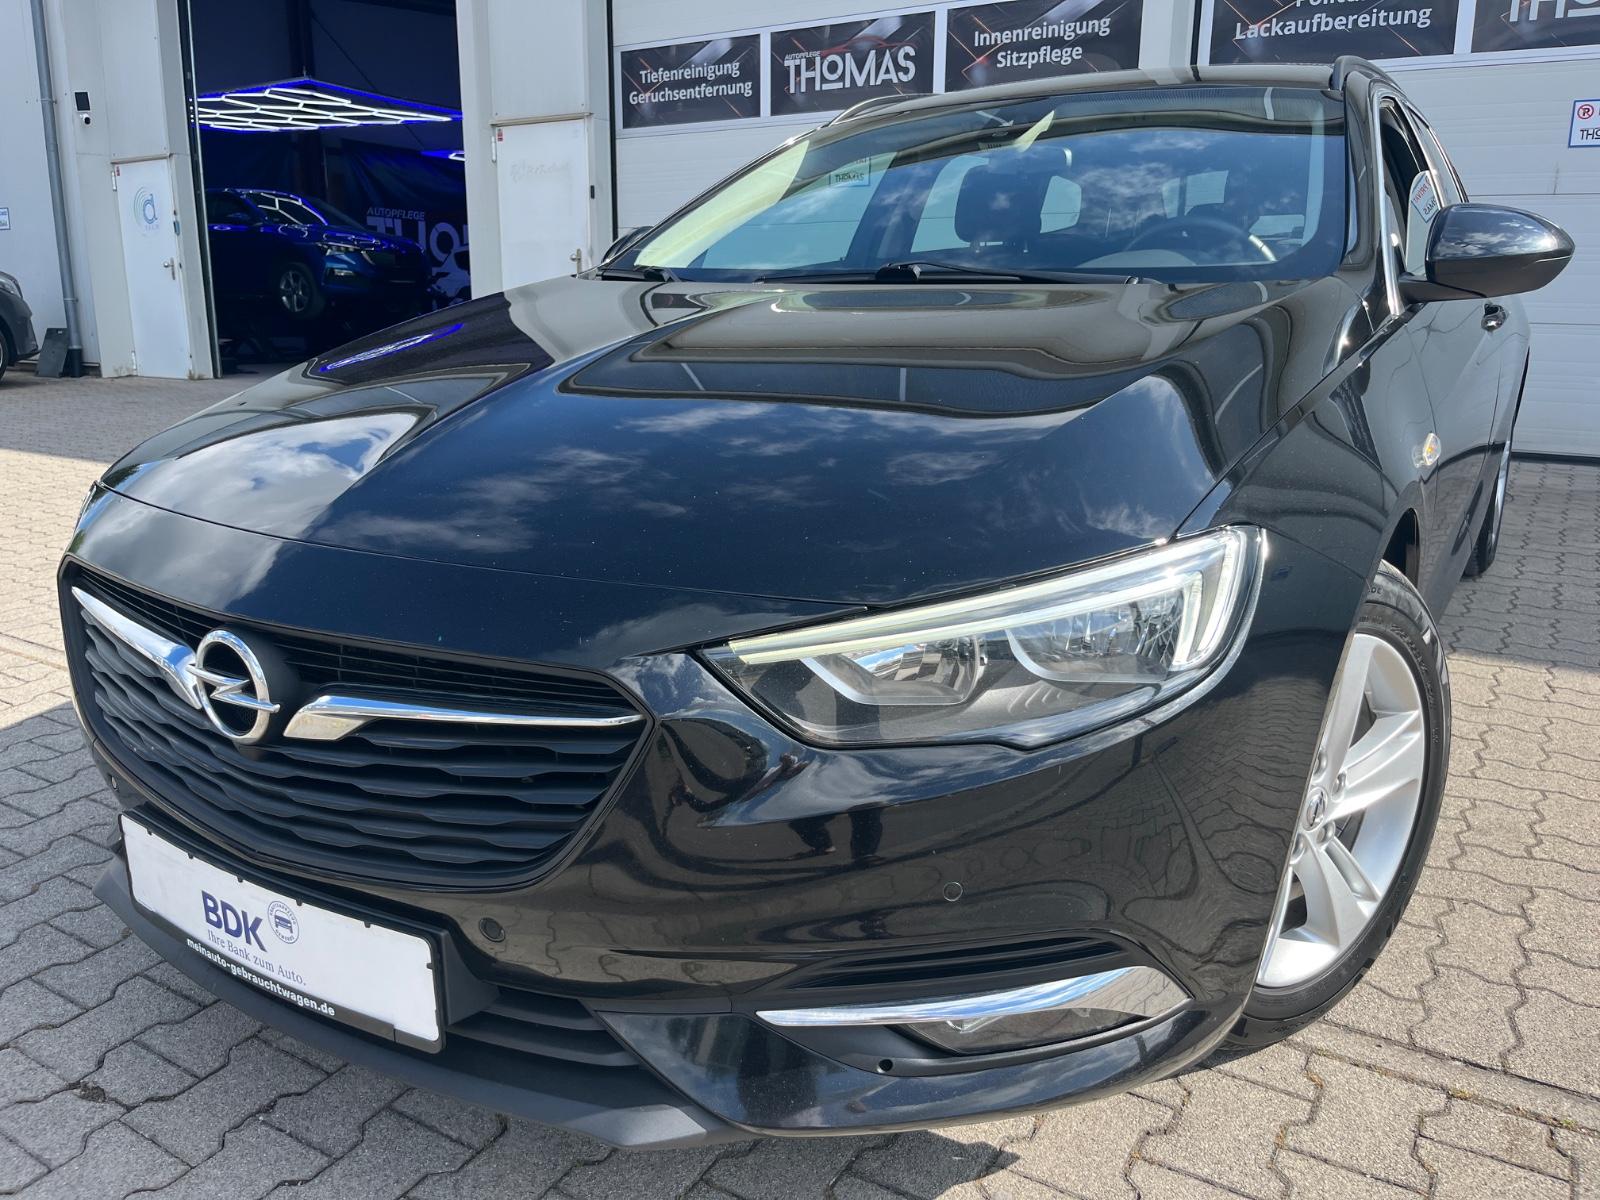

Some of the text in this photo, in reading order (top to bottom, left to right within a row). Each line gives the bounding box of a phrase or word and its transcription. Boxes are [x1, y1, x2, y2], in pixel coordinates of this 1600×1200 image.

[974, 17, 1111, 47] Innenreinigung
[1235, 7, 1432, 40] Lackaufbereitung
[784, 45, 916, 94] THOMAS
[996, 45, 1082, 69] Sitzpflege
[639, 62, 740, 84] Tiefenreinigung
[629, 81, 753, 105] Geruchsentfernung
[367, 207, 426, 220] AUTOPFLEGE
[202, 890, 267, 953] BDK
[208, 929, 307, 986] Ihre Bank zum Auto.
[186, 938, 336, 1016] meinauto-gebrauchtwagen.de
